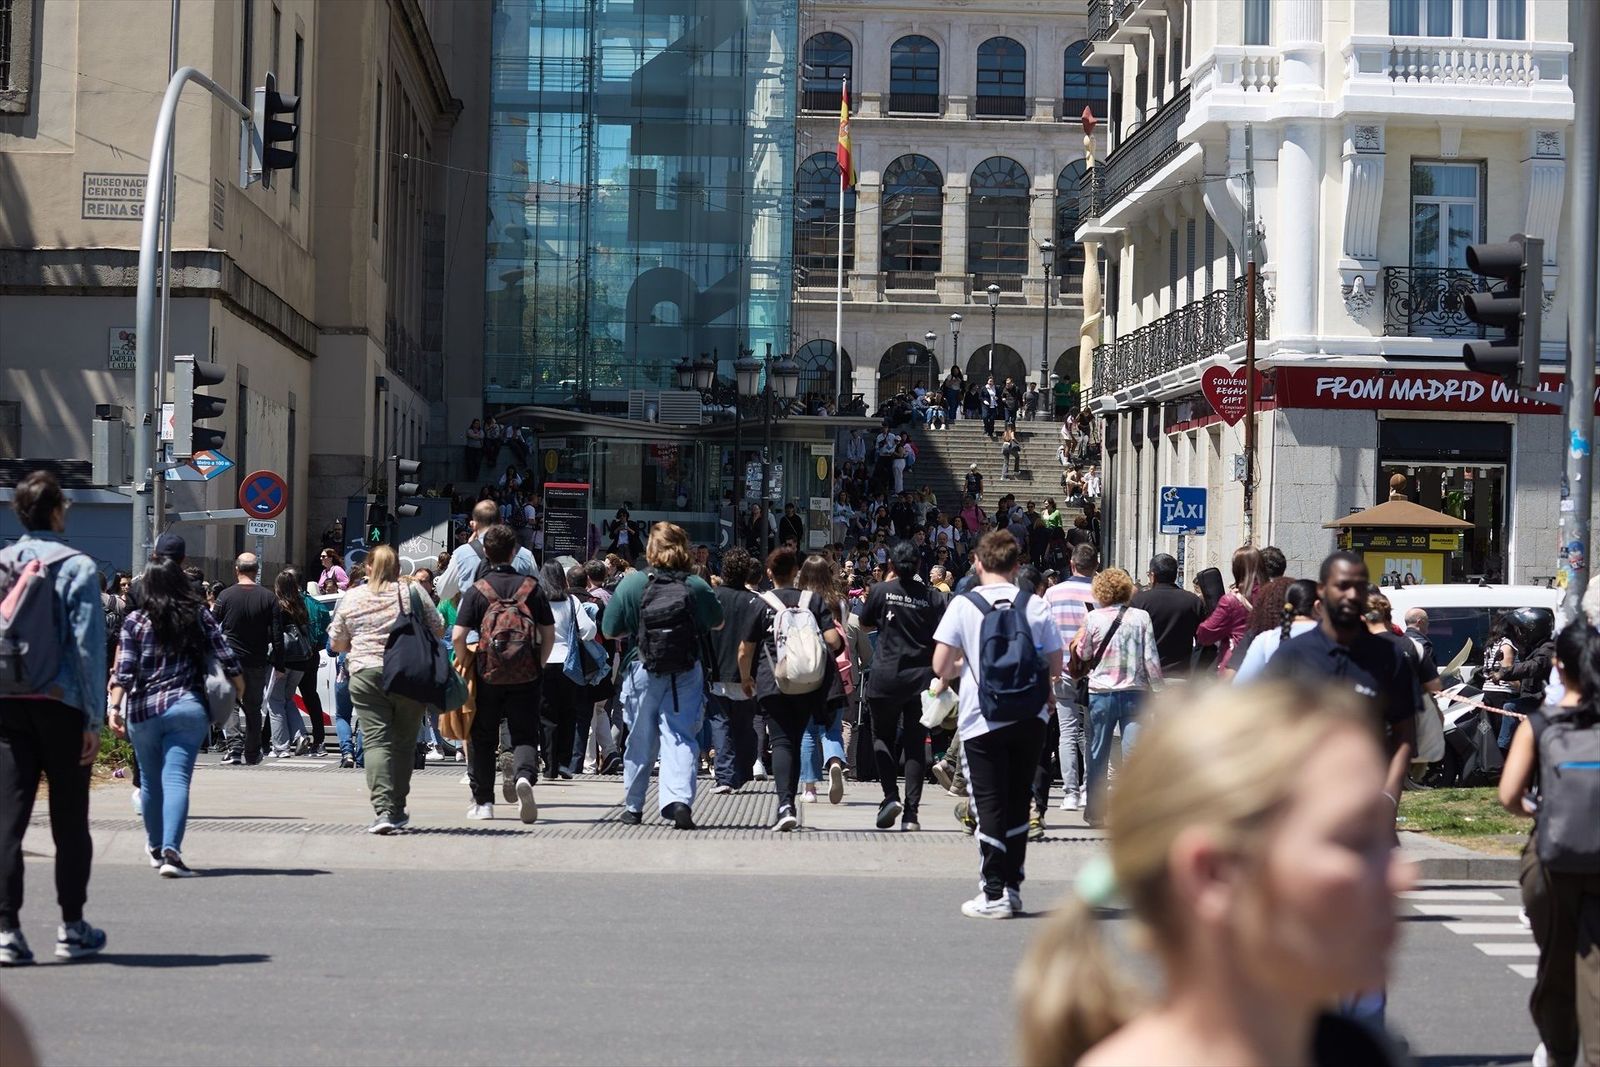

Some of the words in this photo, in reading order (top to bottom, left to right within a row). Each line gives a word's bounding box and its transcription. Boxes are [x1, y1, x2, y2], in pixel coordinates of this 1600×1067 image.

[87, 177, 121, 187] MUSEO
[123, 178, 149, 188] NACI
[87, 187, 127, 197] CENTRO
[130, 188, 142, 197] DE
[87, 203, 128, 216] REINA
[1212, 377, 1247, 386] SOUVENI
[1316, 376, 1384, 400] FROM
[1389, 378, 1485, 402] MADRID
[1222, 396, 1243, 404] GIFT
[1163, 502, 1204, 519] TAXI
[1411, 536, 1426, 544] 120
[885, 592, 903, 602] Here
[904, 595, 912, 603] to
